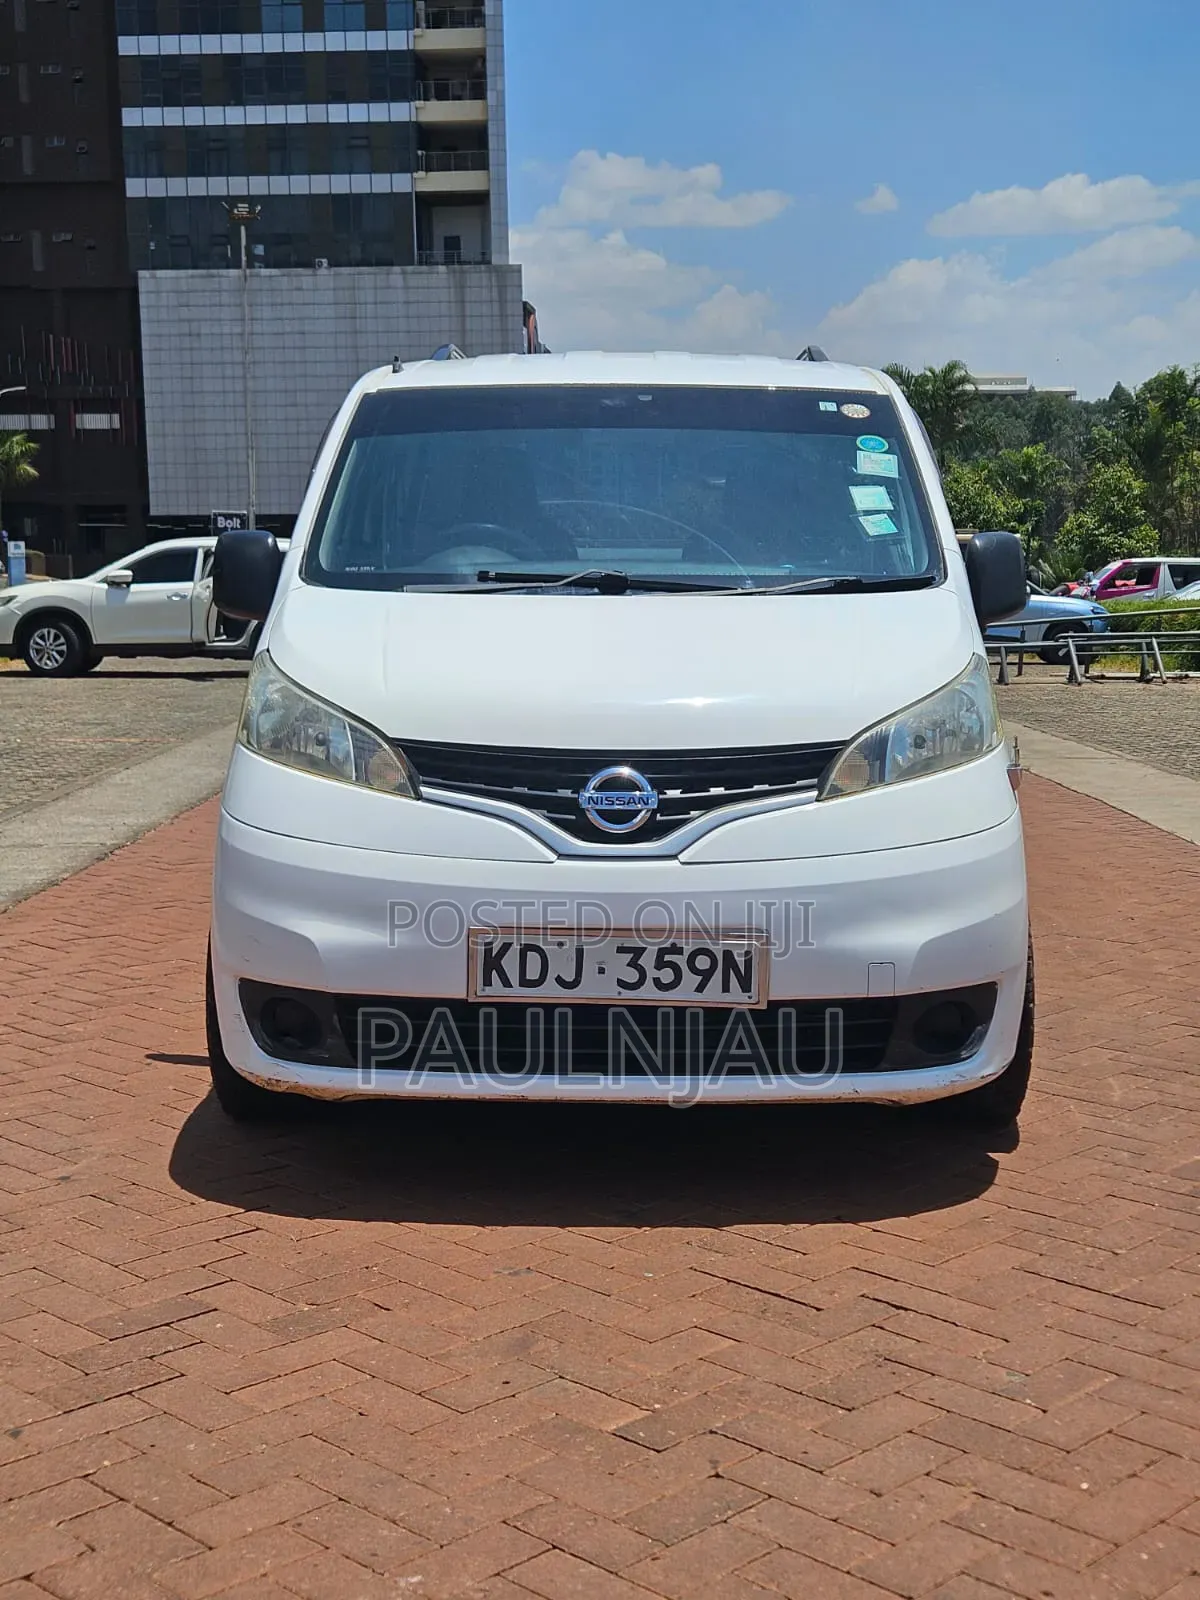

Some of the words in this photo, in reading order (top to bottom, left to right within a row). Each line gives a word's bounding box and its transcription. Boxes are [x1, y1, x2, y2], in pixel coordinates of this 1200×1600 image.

[217, 516, 241, 529] Bolt
[587, 796, 650, 806] NISSAN
[482, 941, 585, 990] KDJ
[615, 943, 753, 994] 359N
